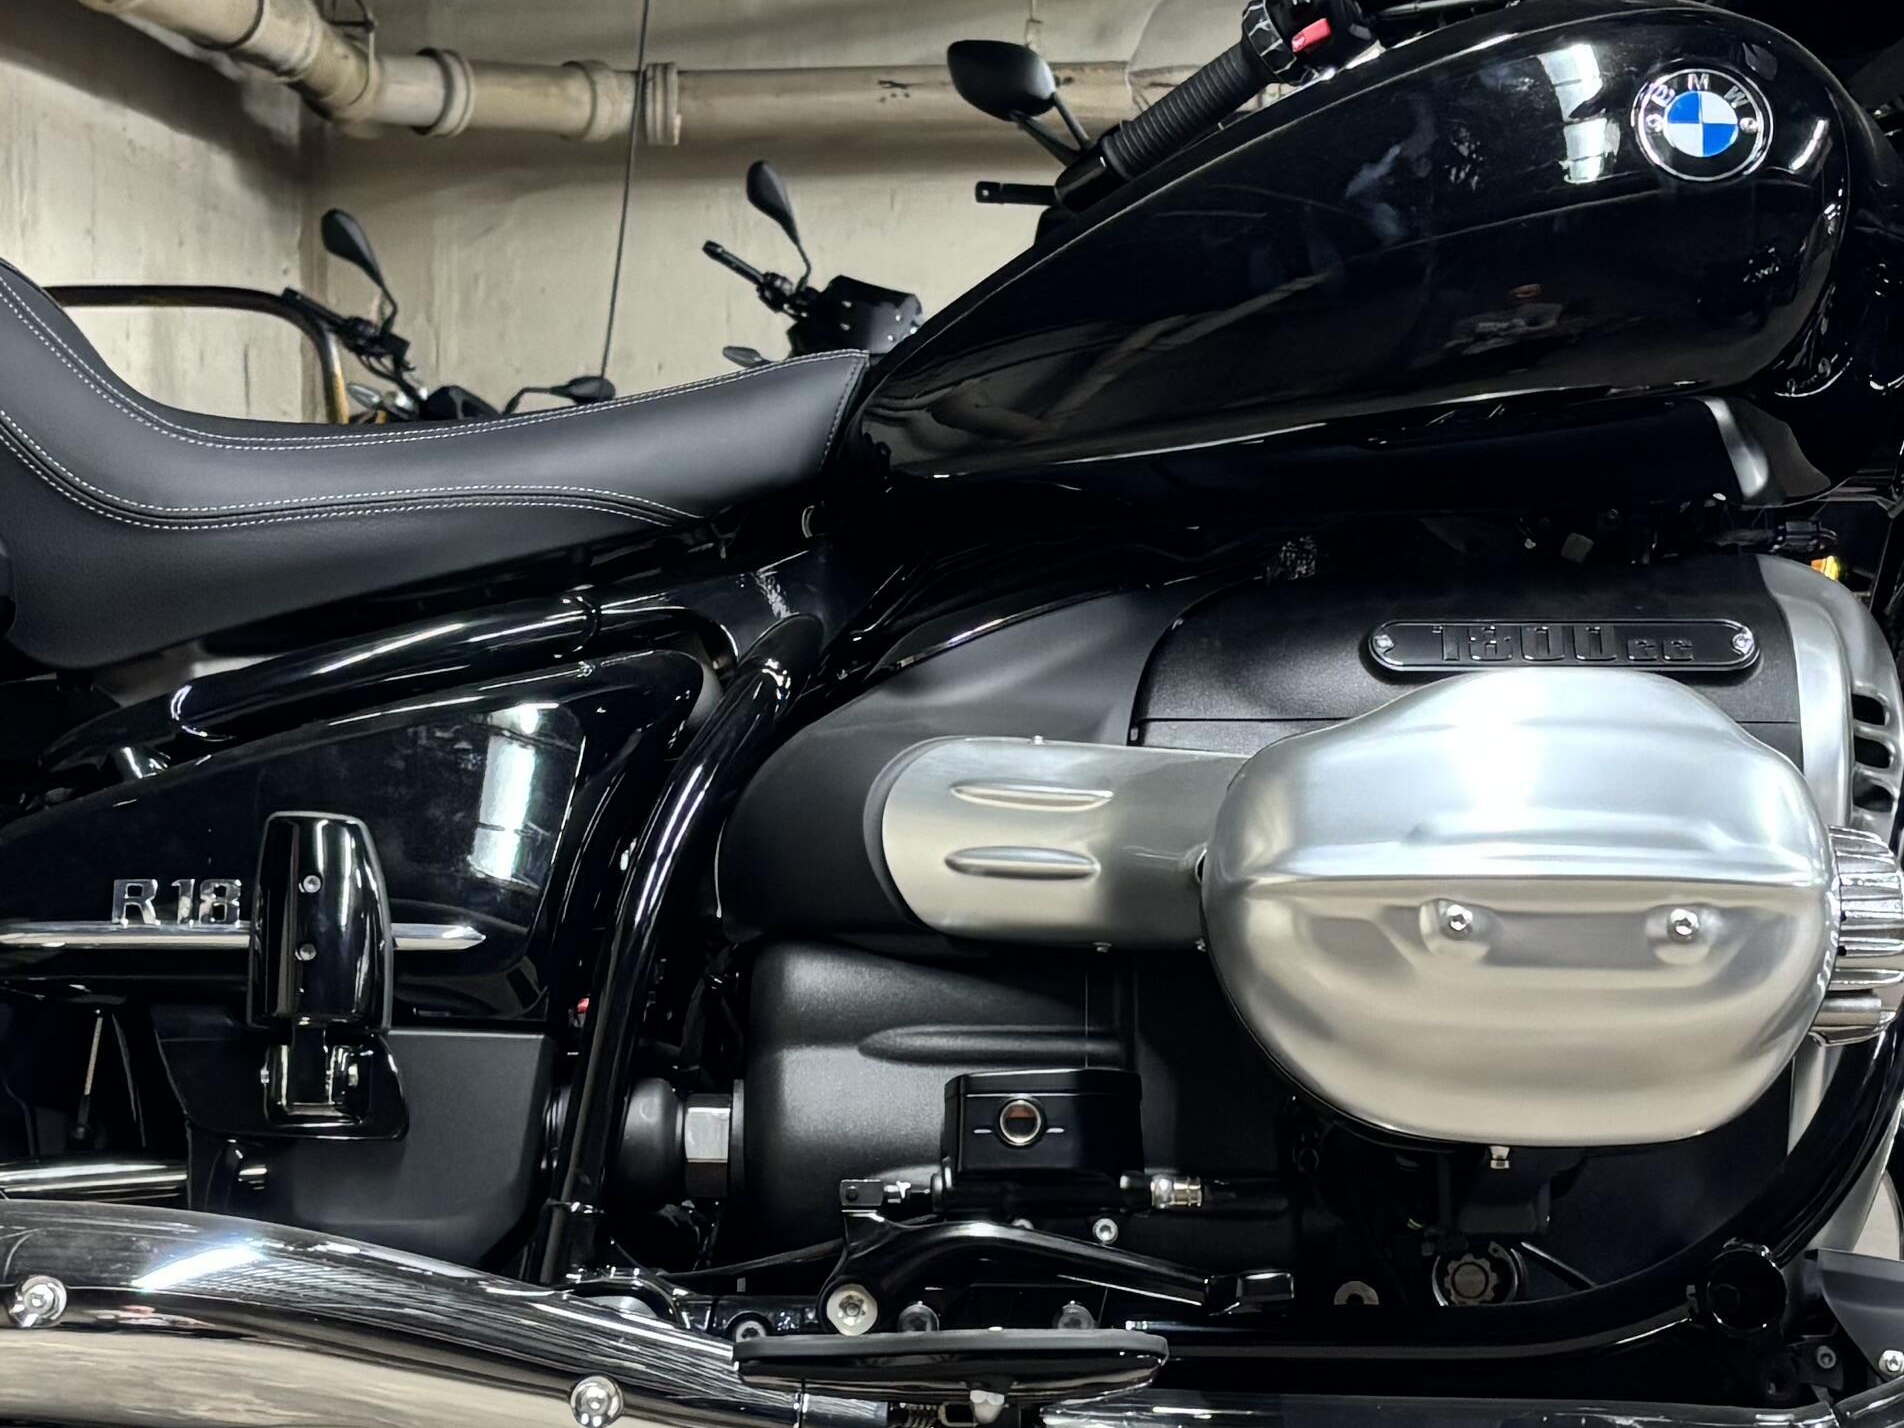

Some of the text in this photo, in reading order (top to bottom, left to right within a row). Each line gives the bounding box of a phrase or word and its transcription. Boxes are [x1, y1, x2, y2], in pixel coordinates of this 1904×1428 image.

[1649, 72, 1750, 110] BMW
[1431, 623, 1618, 662] 1800
[111, 878, 243, 927] R 18
